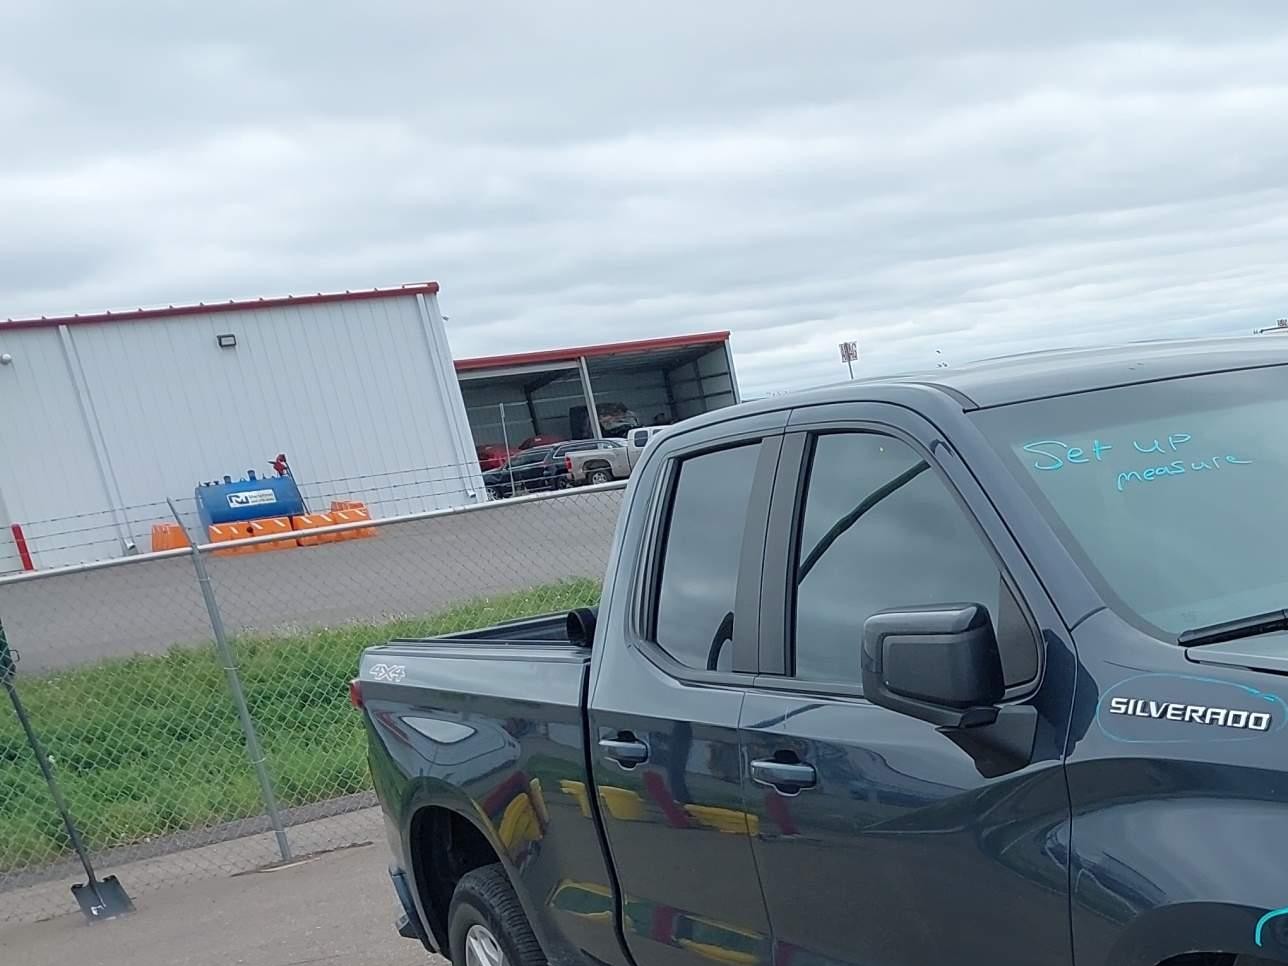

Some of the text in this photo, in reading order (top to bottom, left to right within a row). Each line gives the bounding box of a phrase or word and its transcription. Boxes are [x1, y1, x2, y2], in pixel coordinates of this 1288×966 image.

[1023, 440, 1112, 470] Set
[1115, 455, 1254, 491] measure
[1109, 697, 1272, 731] SILVERADO
